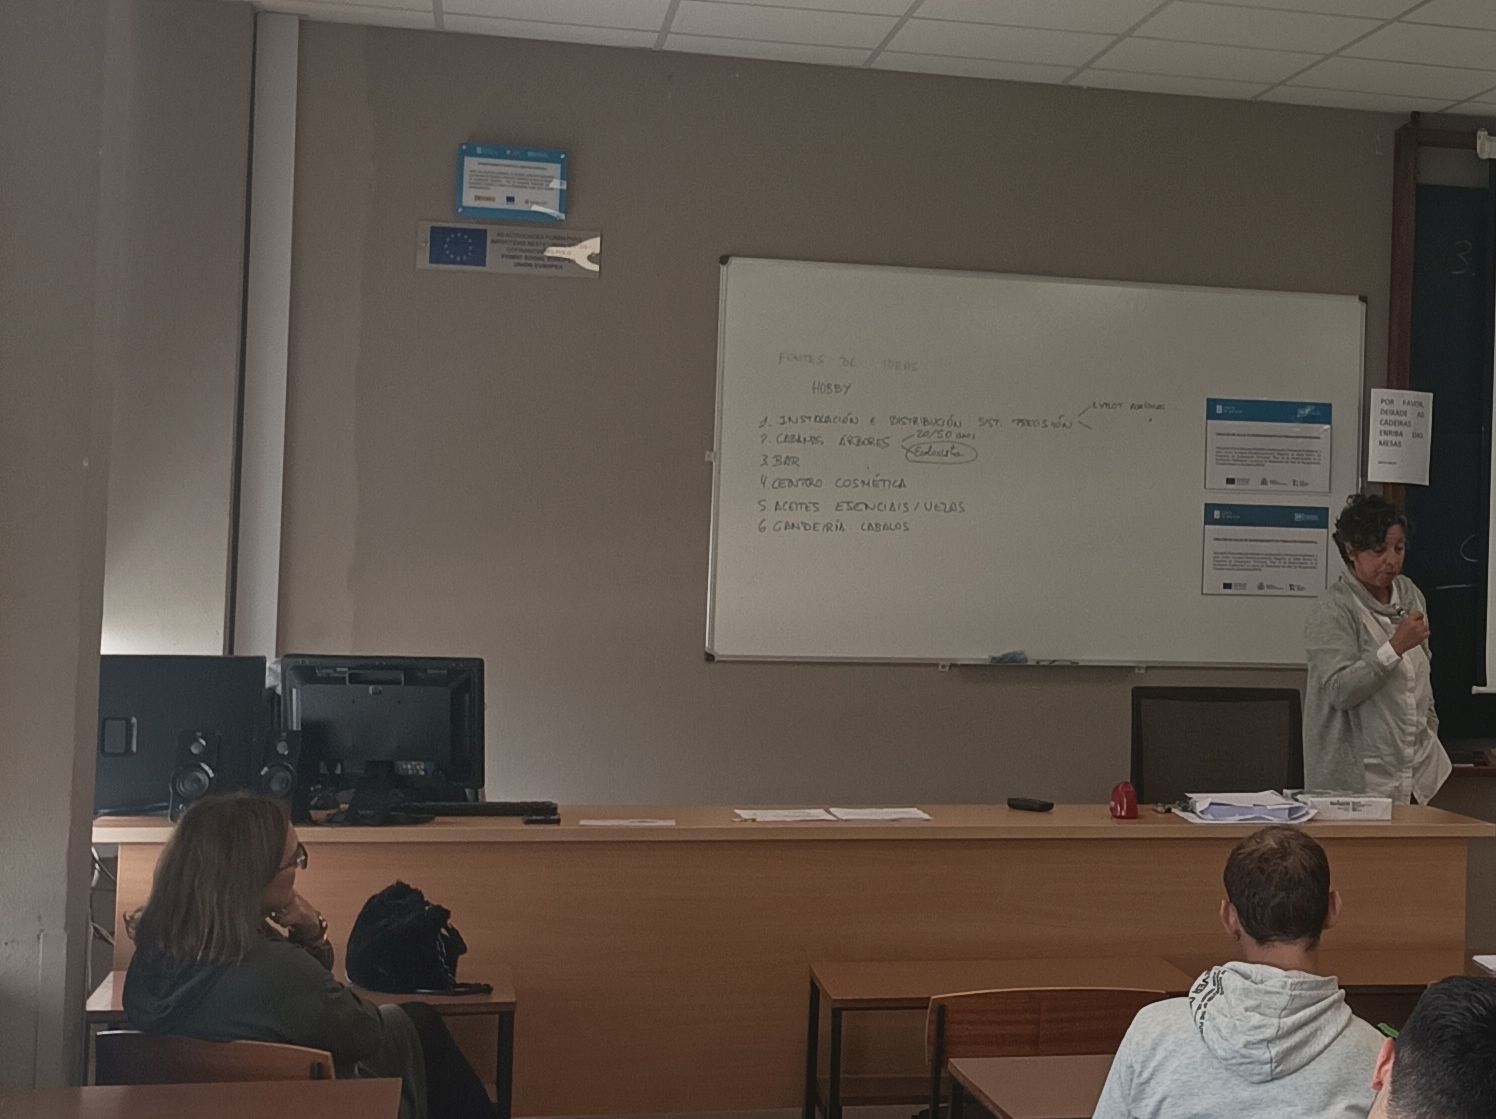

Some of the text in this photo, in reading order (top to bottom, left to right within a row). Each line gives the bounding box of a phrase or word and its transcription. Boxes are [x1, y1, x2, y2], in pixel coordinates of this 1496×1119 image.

[811, 380, 852, 396] HOBBY
[1379, 419, 1412, 428] CADEIRAS
[1379, 440, 1402, 448] MESAS
[772, 454, 801, 467] BAR
[834, 473, 907, 489] COSMÉTICA
[861, 521, 911, 532] CABALOS
